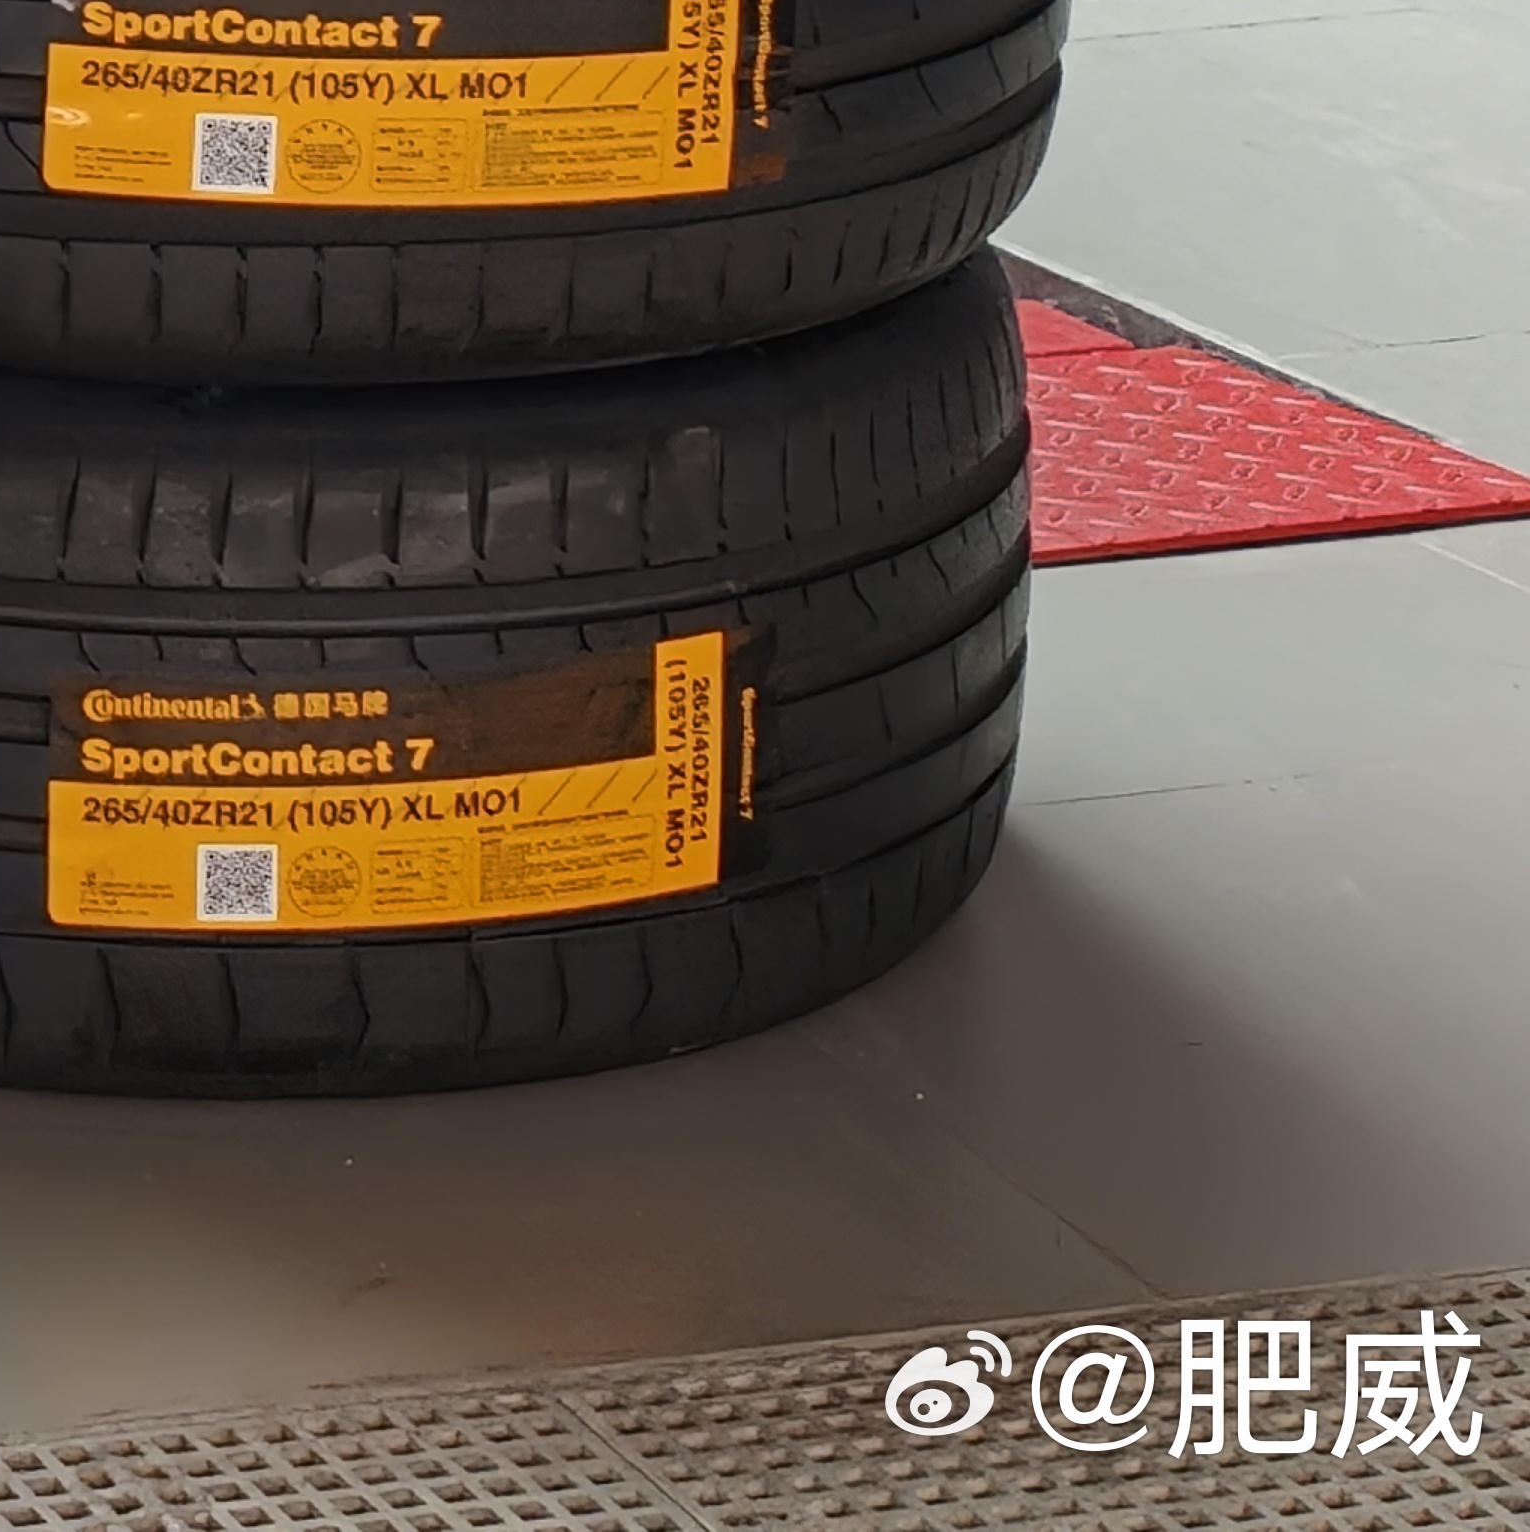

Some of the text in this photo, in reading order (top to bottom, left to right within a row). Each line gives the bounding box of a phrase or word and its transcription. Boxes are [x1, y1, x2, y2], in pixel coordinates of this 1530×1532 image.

[82, 1, 443, 50] SportContact 7
[81, 59, 529, 105] 265/40ZR21 (105Y) XL MO1
[677, 61, 699, 100] XL
[673, 108, 697, 170] MO1
[82, 688, 242, 723] Continental
[81, 738, 436, 779] SportContact 7
[664, 658, 688, 870] (105Y) XL MO1
[82, 788, 523, 834] 265/40ZR21 (105Y) XL MO1
